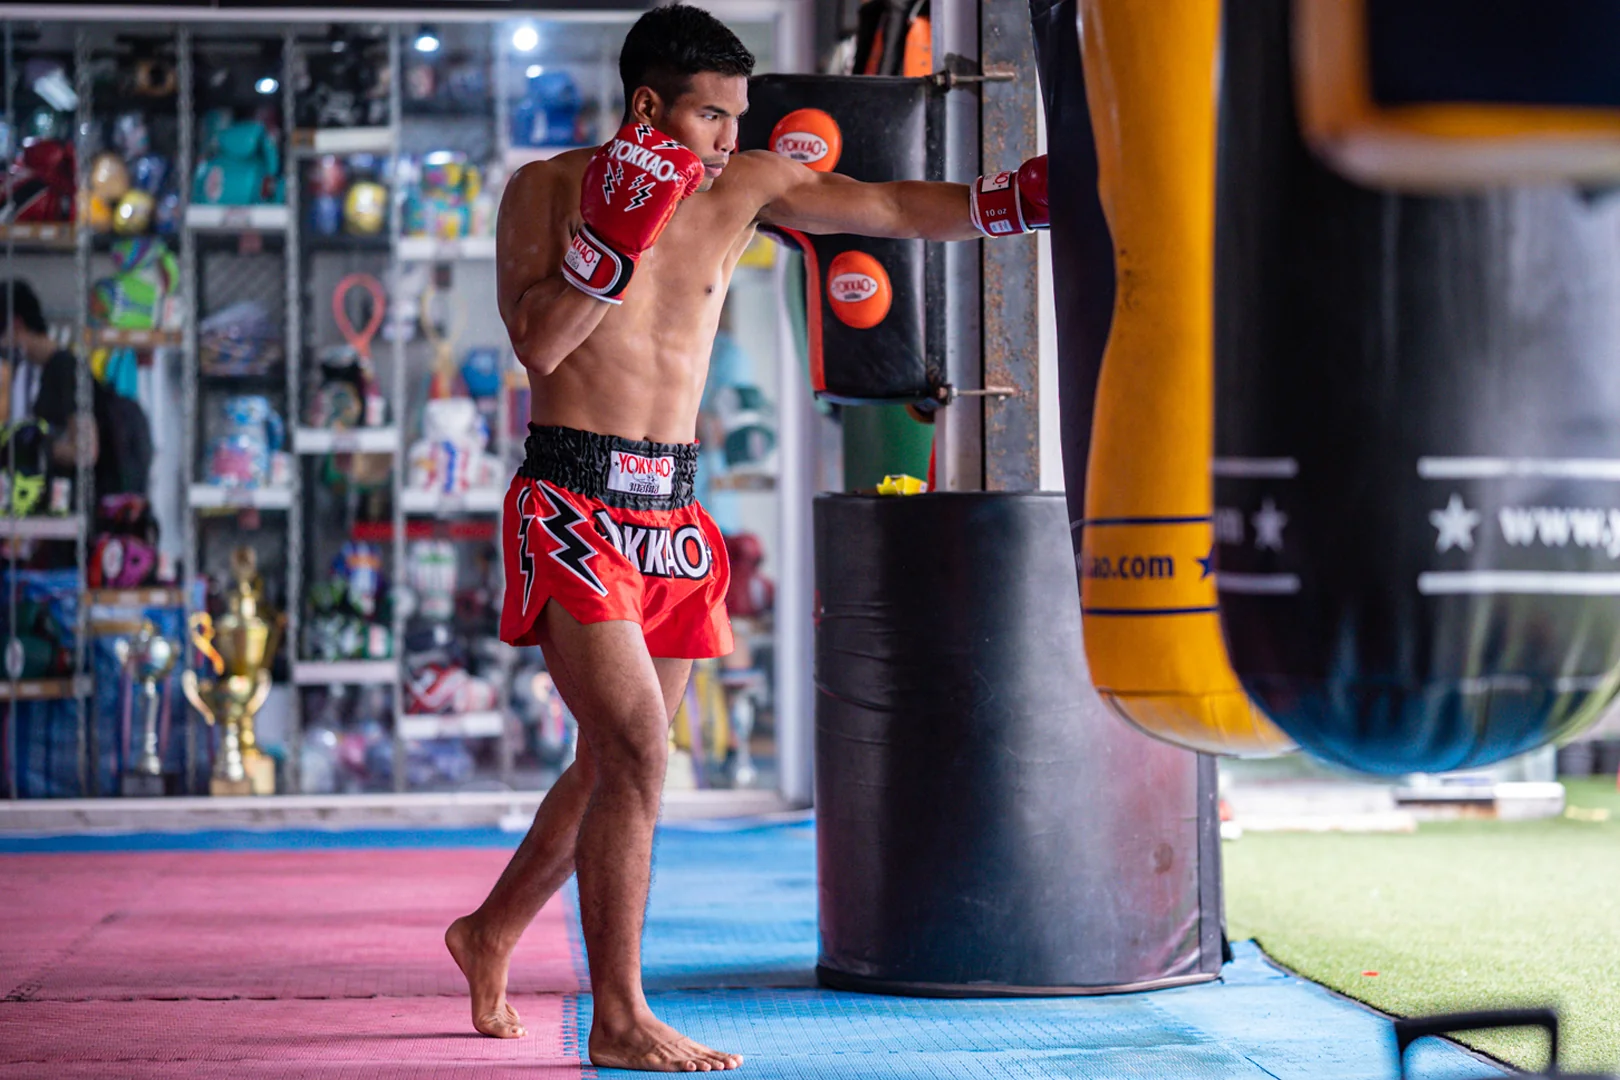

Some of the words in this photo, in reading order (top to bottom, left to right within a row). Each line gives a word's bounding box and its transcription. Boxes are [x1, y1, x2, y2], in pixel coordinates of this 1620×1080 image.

[609, 139, 675, 182] YOKKAO
[985, 209, 995, 217] 10
[618, 452, 671, 477] YOKKAO
